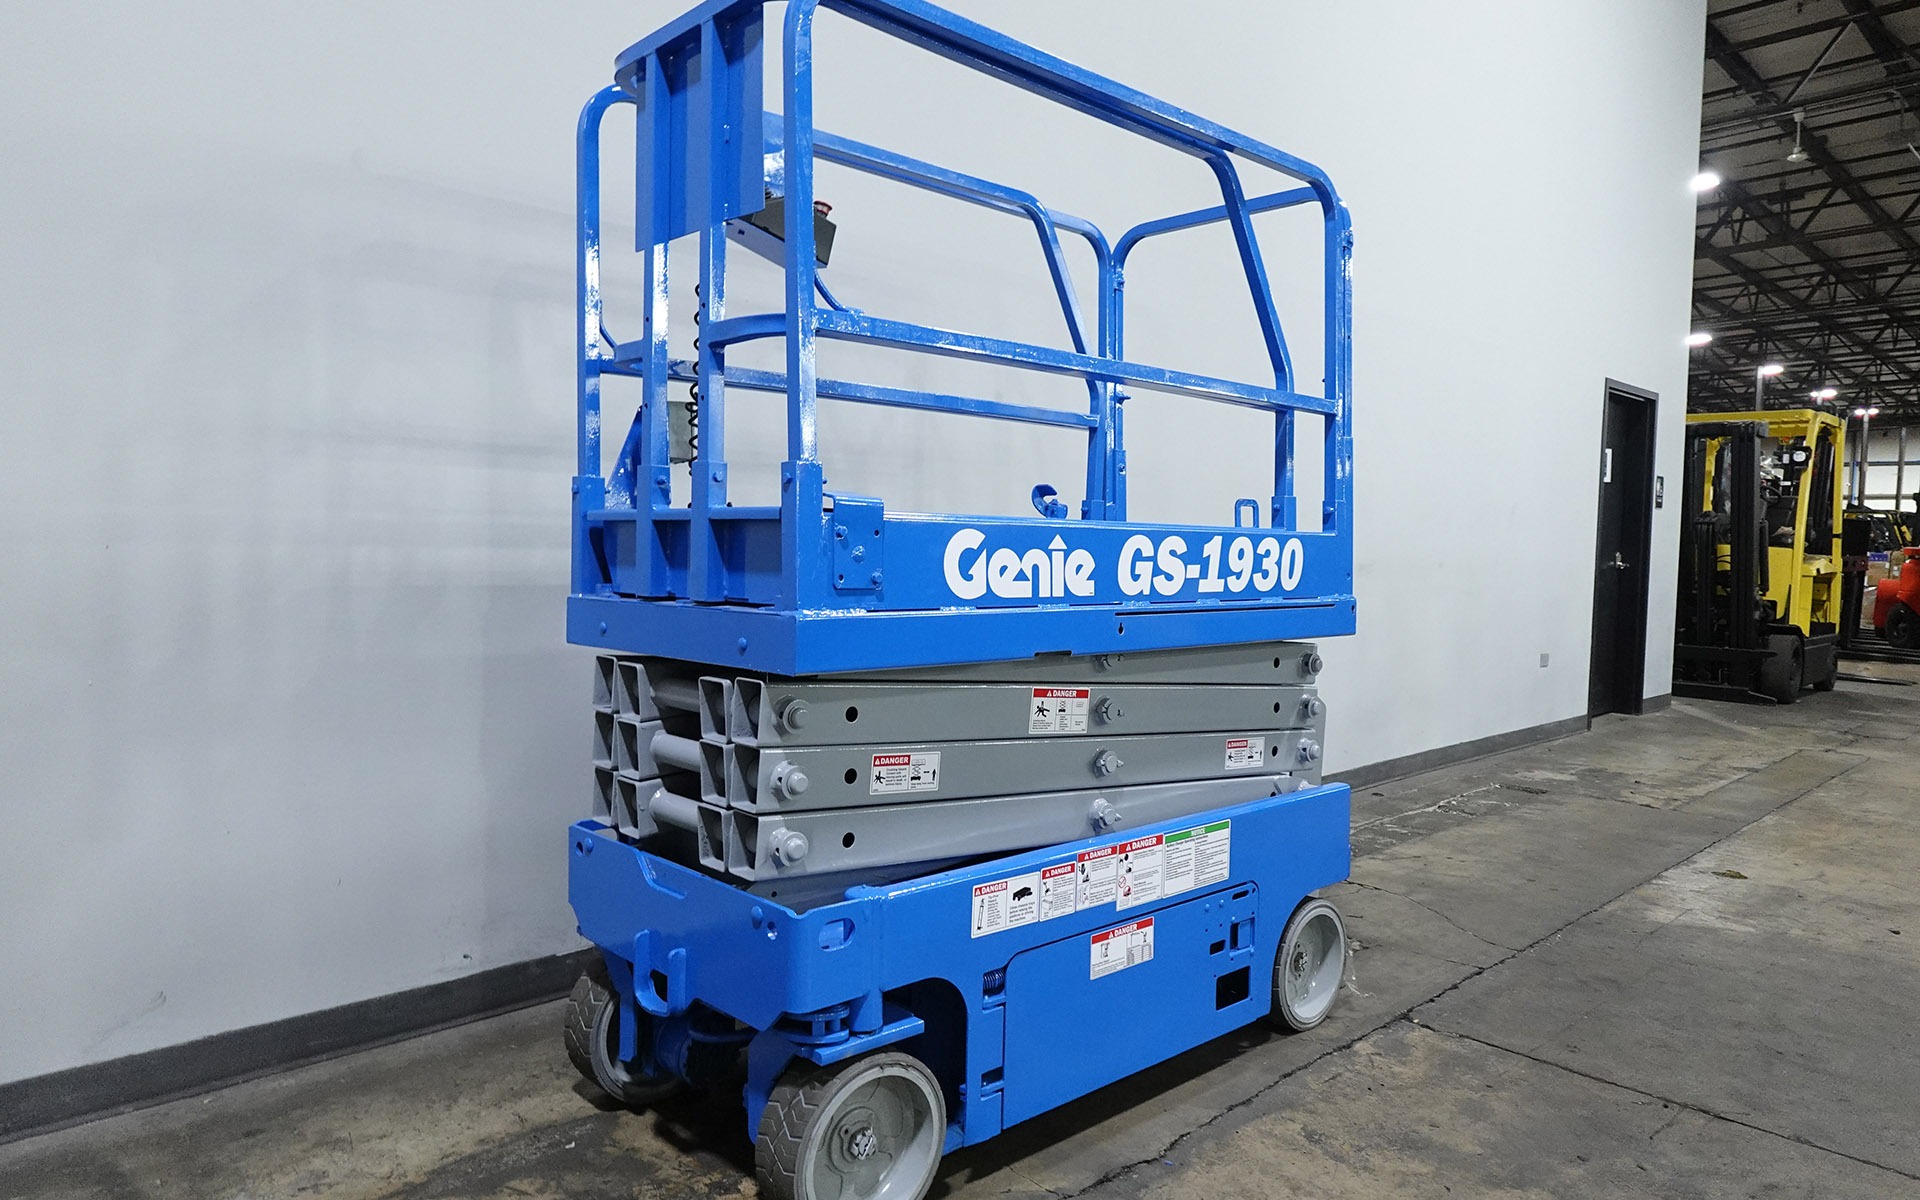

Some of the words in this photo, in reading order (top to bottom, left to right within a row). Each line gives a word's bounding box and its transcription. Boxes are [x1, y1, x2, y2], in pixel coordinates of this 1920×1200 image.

[944, 528, 1096, 600] Genie
[1117, 534, 1304, 597] GS-1930
[1052, 690, 1077, 698] DANGER
[880, 756, 909, 765] DANGER
[1132, 837, 1157, 850] DANGER
[1089, 848, 1112, 860] DANGER
[1050, 865, 1072, 877] DANGER
[981, 881, 1007, 895] DANGER
[1114, 923, 1138, 938] DANGER
